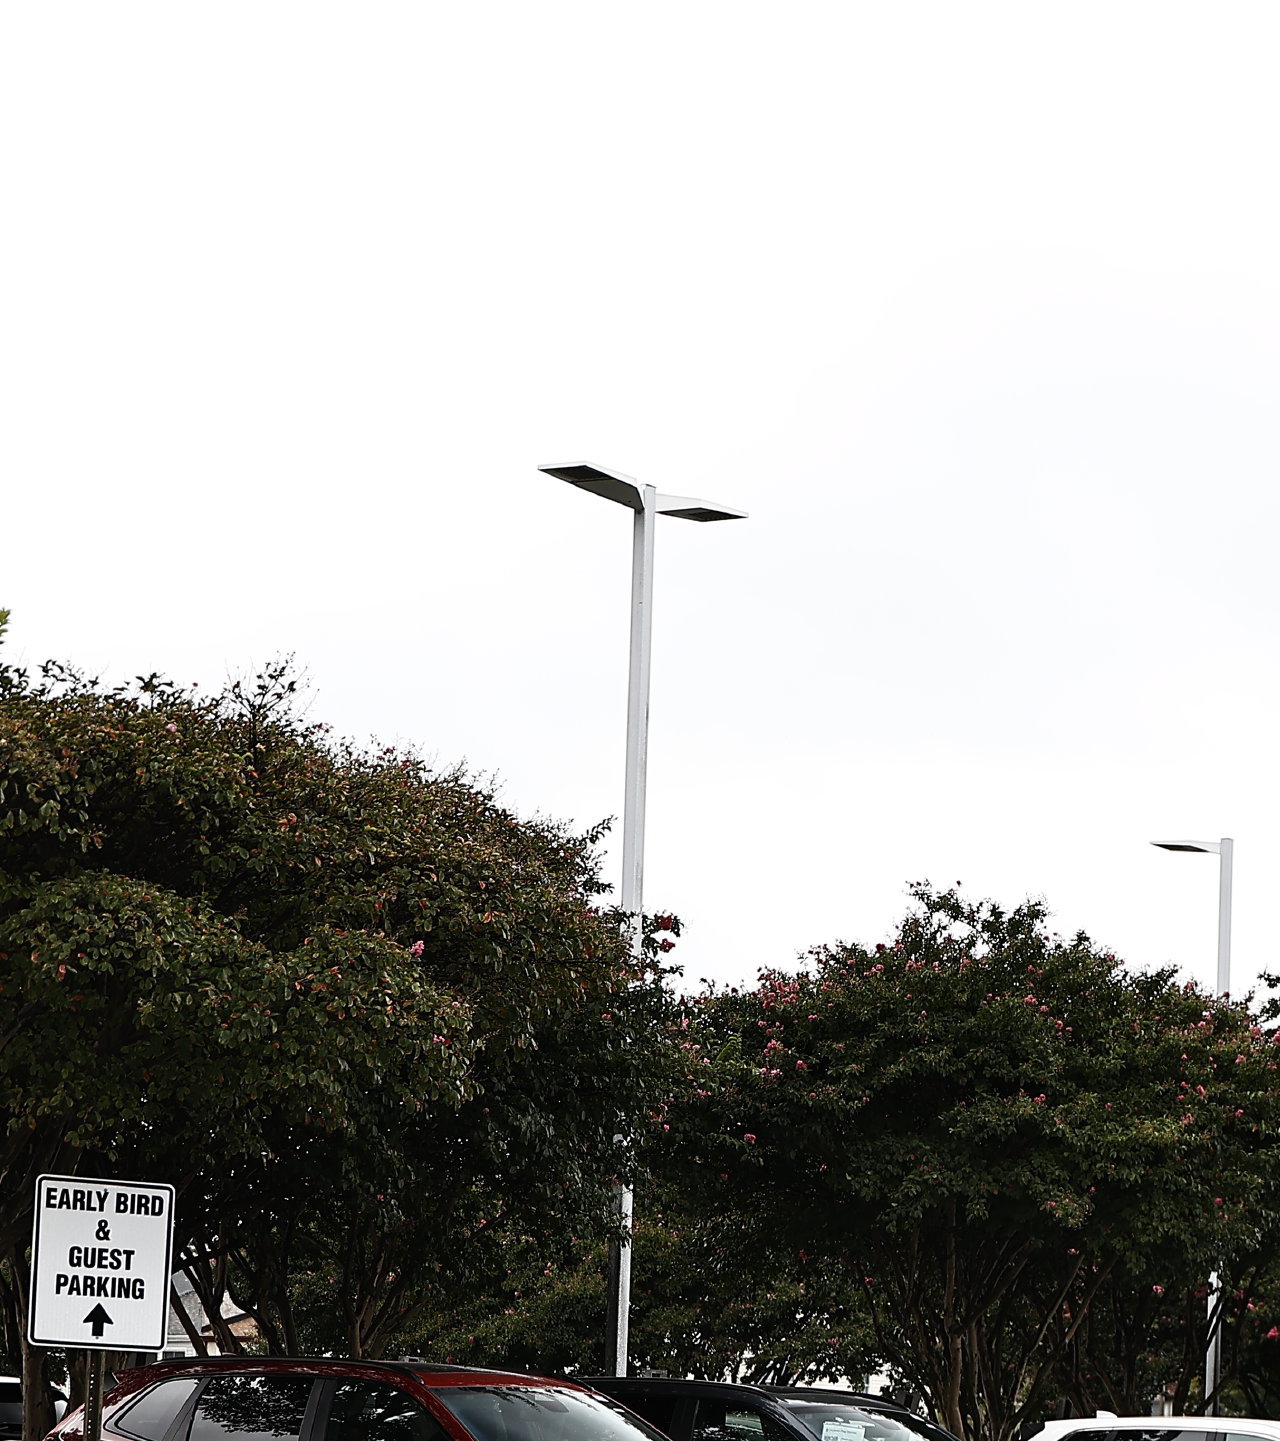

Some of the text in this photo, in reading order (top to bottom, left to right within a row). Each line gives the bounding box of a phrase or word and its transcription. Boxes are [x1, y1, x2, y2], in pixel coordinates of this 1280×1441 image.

[46, 1187, 164, 1217] EARLY BIRD
[95, 1219, 111, 1241] &
[68, 1246, 135, 1270] GUEST
[55, 1273, 145, 1300] PARKING
